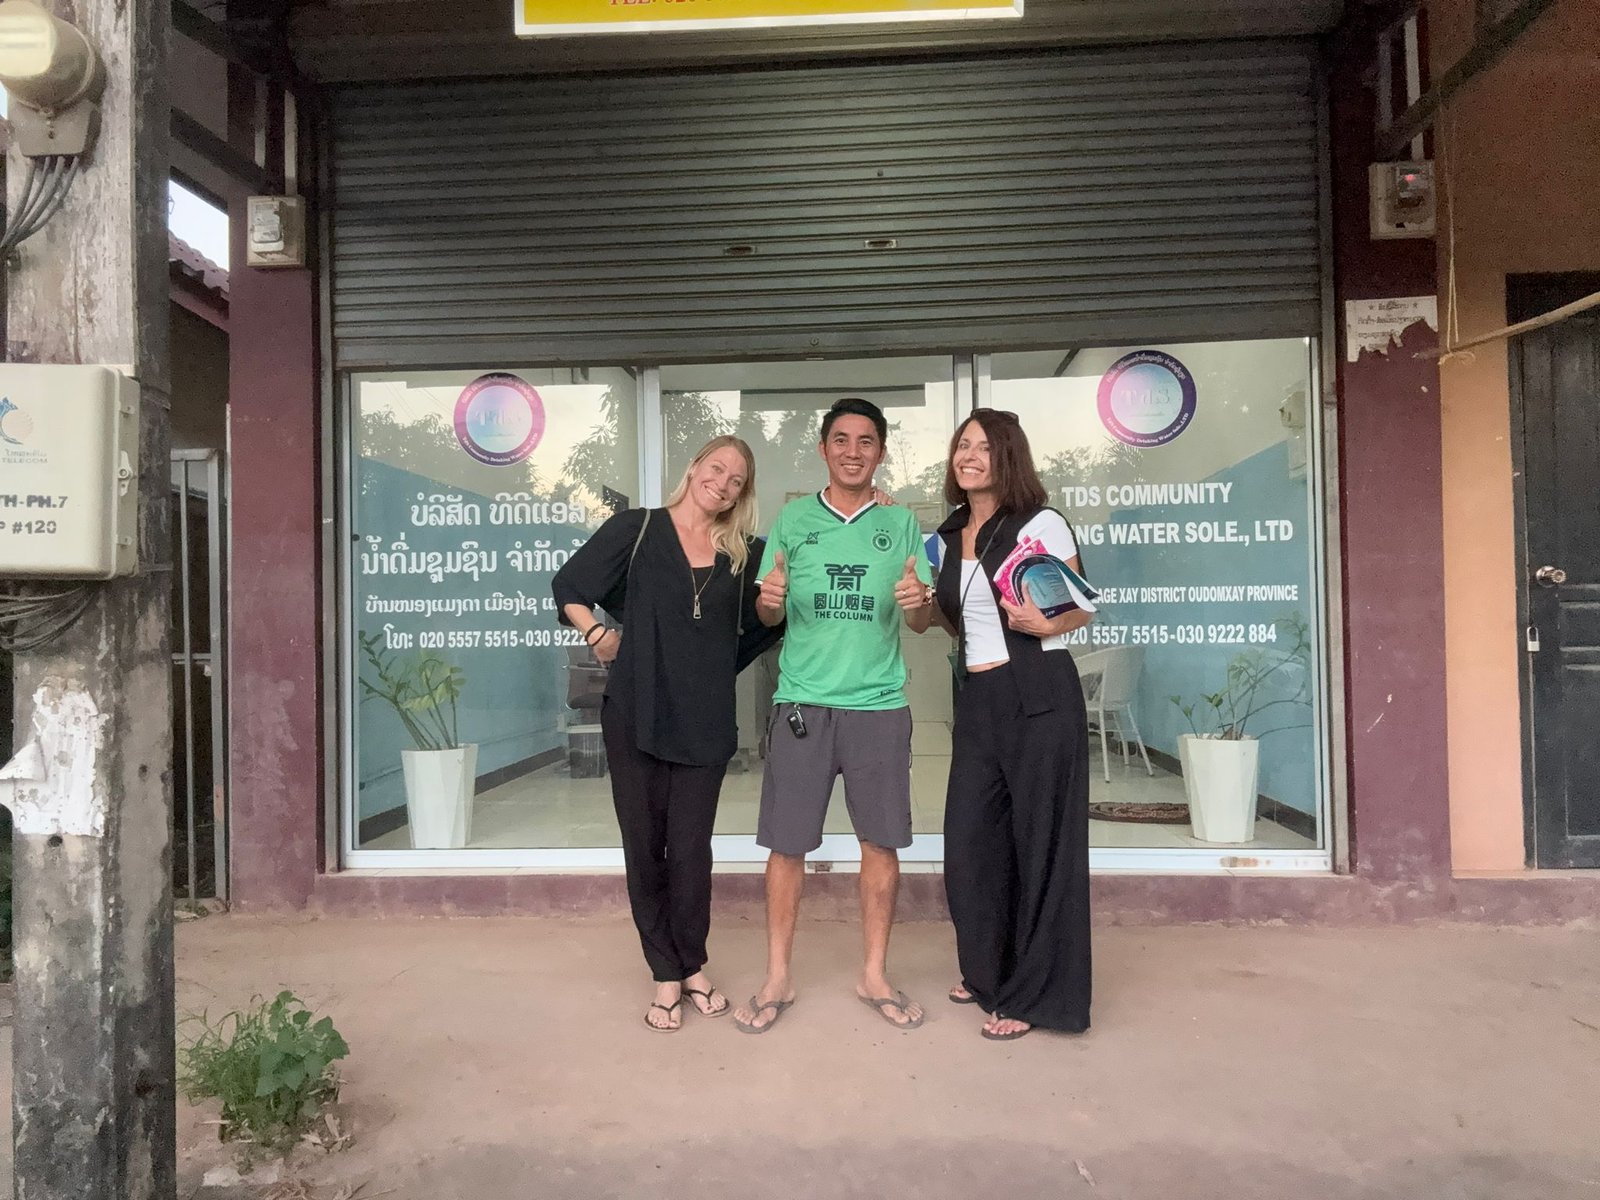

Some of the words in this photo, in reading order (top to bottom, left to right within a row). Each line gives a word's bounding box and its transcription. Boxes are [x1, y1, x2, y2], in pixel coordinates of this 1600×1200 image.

[1062, 486, 1101, 507] TDS
[1106, 482, 1232, 507] COMMUNITY
[411, 492, 481, 526] ບໍລິສັດ
[1071, 524, 1104, 546] NG
[1108, 522, 1180, 545] WATER
[1185, 521, 1250, 547] SOLE.,
[1255, 520, 1294, 542] LTD
[1119, 587, 1138, 603] XAY
[1140, 586, 1186, 603] DISTRICT
[1188, 585, 1245, 602] OUDOMXAY
[1247, 584, 1298, 602] PROVINCE
[814, 611, 831, 619] THE
[833, 611, 873, 622] COLUMN
[420, 631, 445, 648] 020
[448, 630, 480, 648] 5557
[485, 628, 551, 647] 5515-030
[554, 629, 587, 646] 9222
[1061, 625, 1087, 645] 020
[1092, 625, 1127, 645] 5557
[1132, 624, 1203, 645] 5515-030
[1208, 623, 1245, 643] 9222
[1249, 622, 1277, 643] 884
